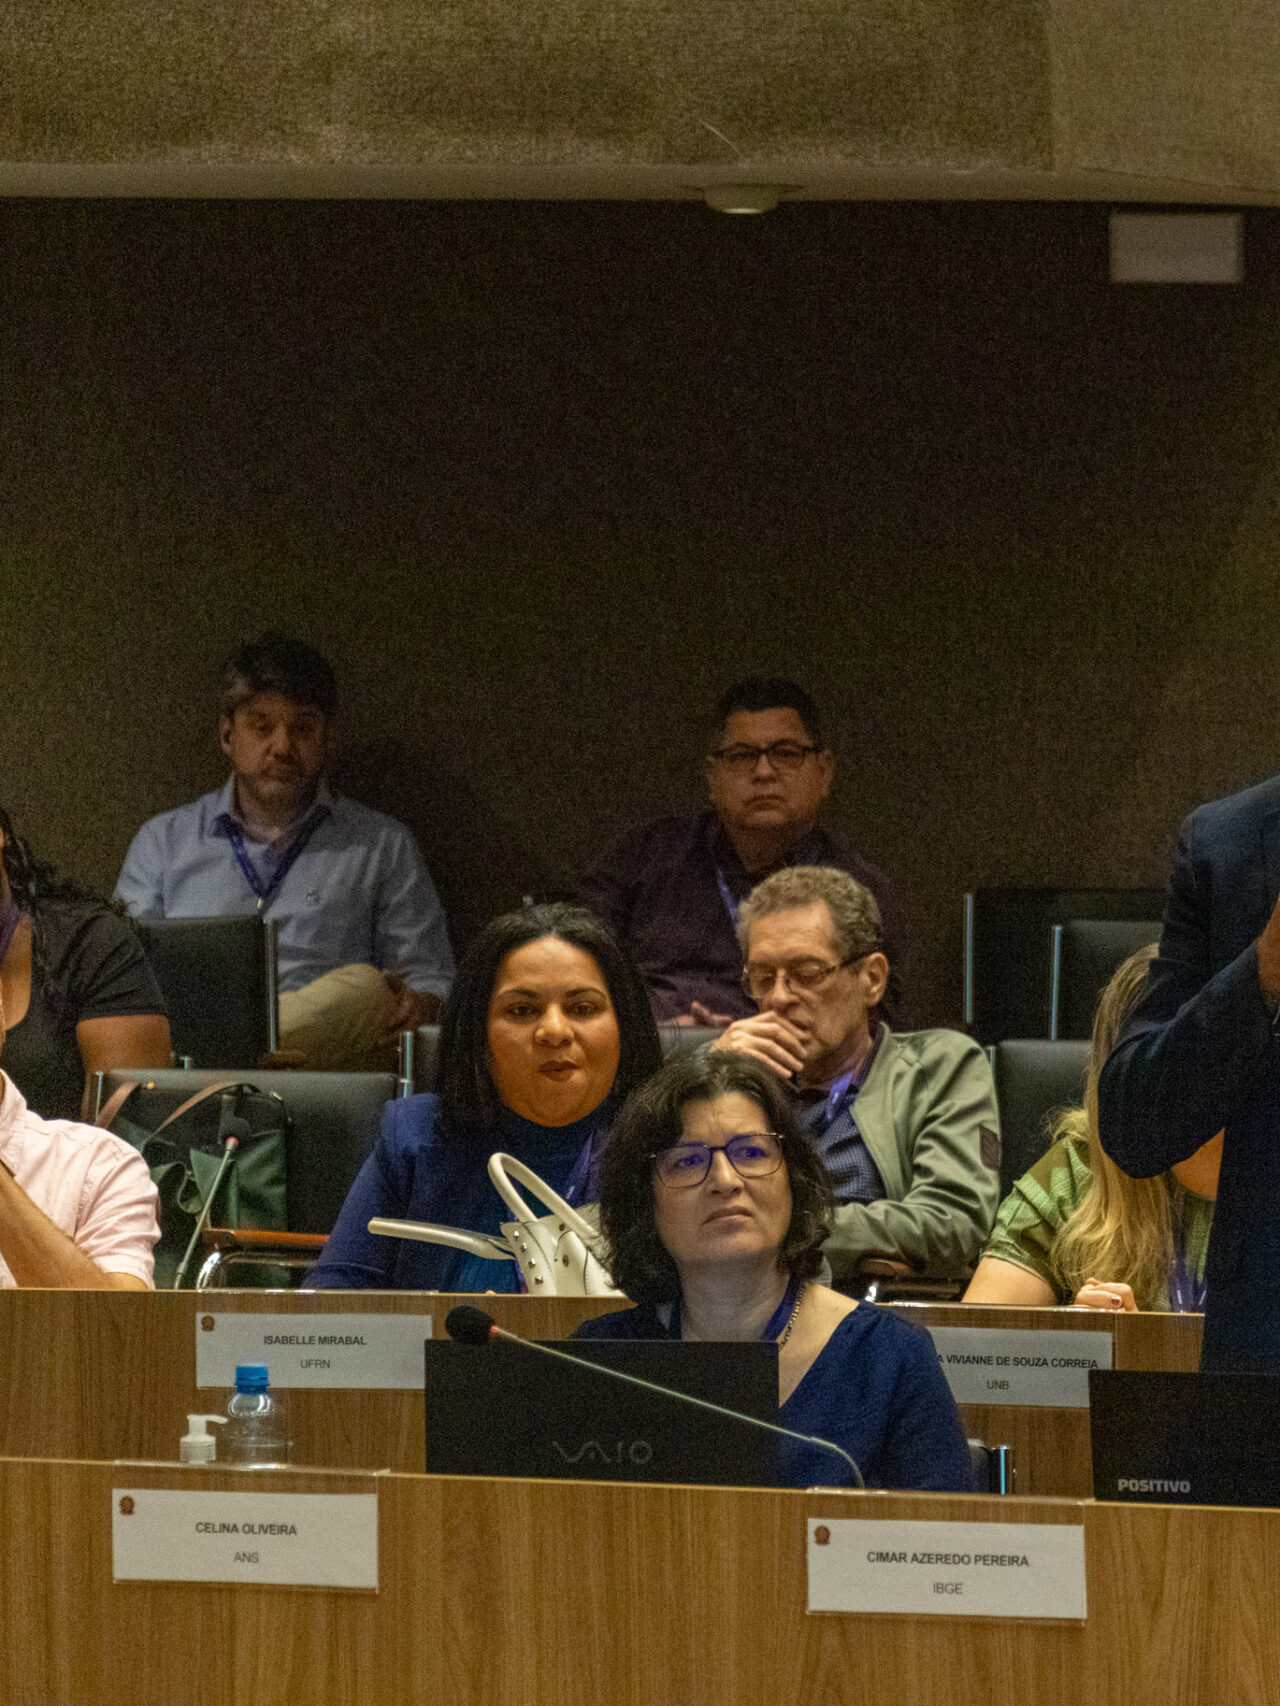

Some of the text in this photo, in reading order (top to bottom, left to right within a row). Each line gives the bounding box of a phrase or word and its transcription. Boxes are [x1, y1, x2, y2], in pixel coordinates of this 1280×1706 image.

[263, 1335, 367, 1346] ISABELLE MIRABAL
[300, 1359, 331, 1369] UFRN
[947, 1354, 994, 1366] VIVIANNE
[996, 1356, 1010, 1366] DE
[1012, 1357, 1049, 1367] SOUZA
[1051, 1358, 1099, 1369] CORREIA
[986, 1380, 1010, 1390] UNB
[551, 1440, 654, 1464] VAIO
[1117, 1479, 1192, 1493] POSITIVO
[195, 1521, 297, 1536] CELINA OLIVEIRA
[233, 1551, 260, 1564] ANS
[866, 1551, 1030, 1567] CIMAR AZEREDO PEREIRA
[932, 1582, 964, 1595] IBGE
